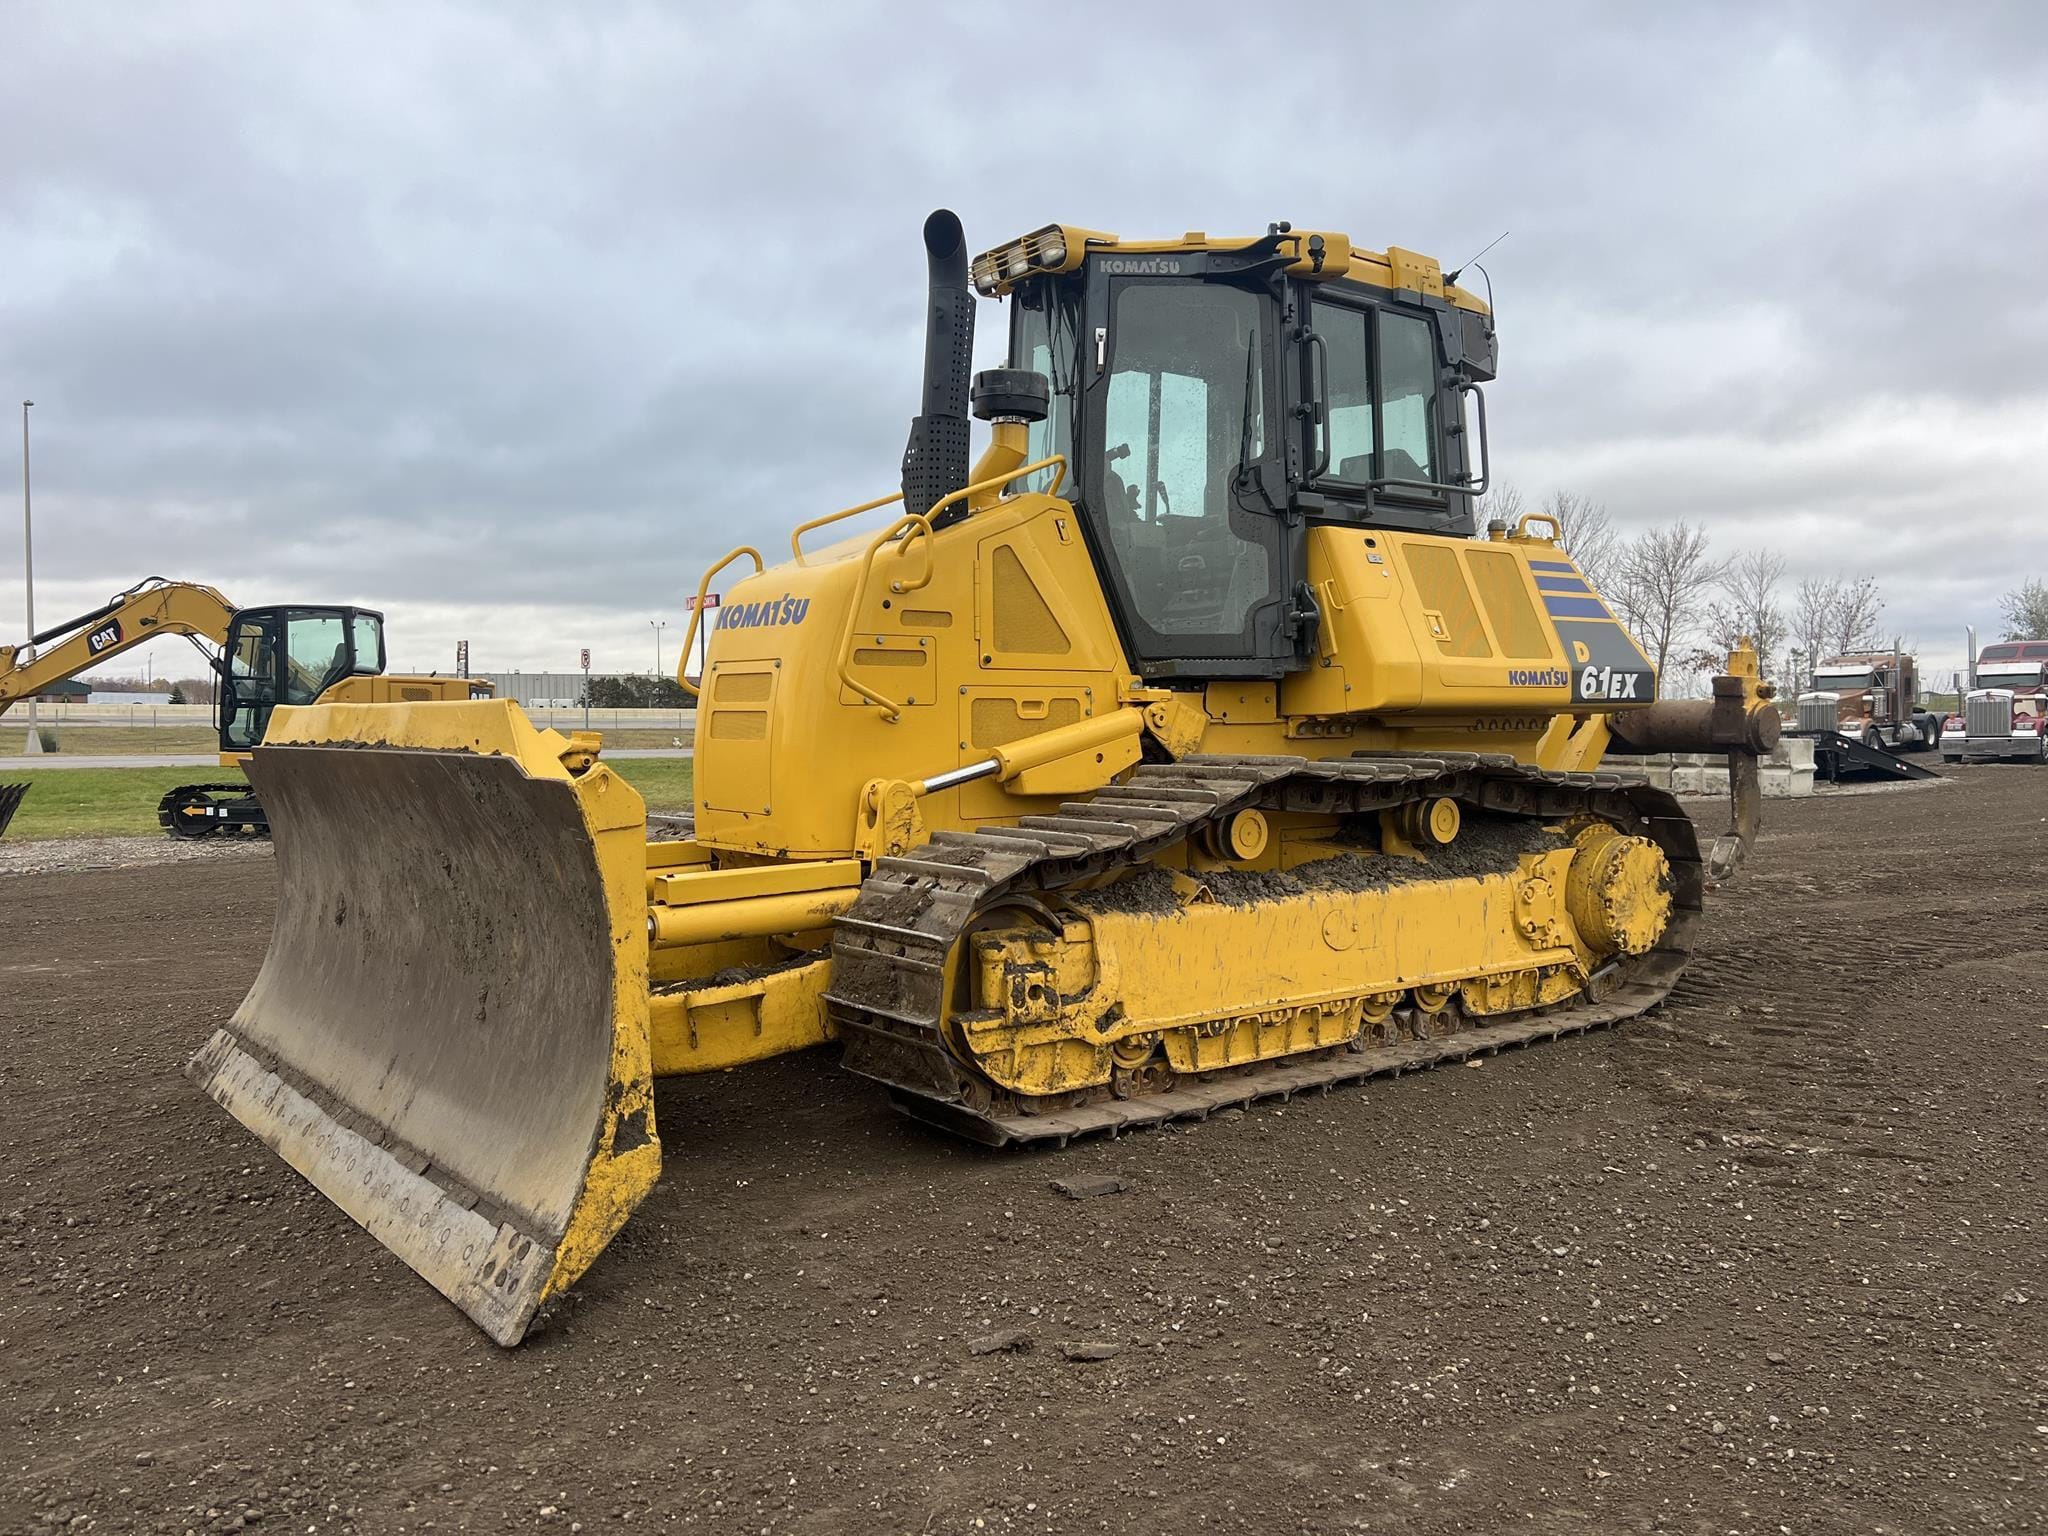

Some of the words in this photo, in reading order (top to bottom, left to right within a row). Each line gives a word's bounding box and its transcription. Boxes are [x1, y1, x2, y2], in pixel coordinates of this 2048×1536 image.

[1100, 258, 1180, 274] KOMATSU
[715, 593, 810, 630] KOMATSU
[91, 627, 118, 650] CAT
[1572, 640, 1590, 663] D
[1508, 667, 1568, 686] KOMATSU
[1580, 666, 1639, 699] 61EX
